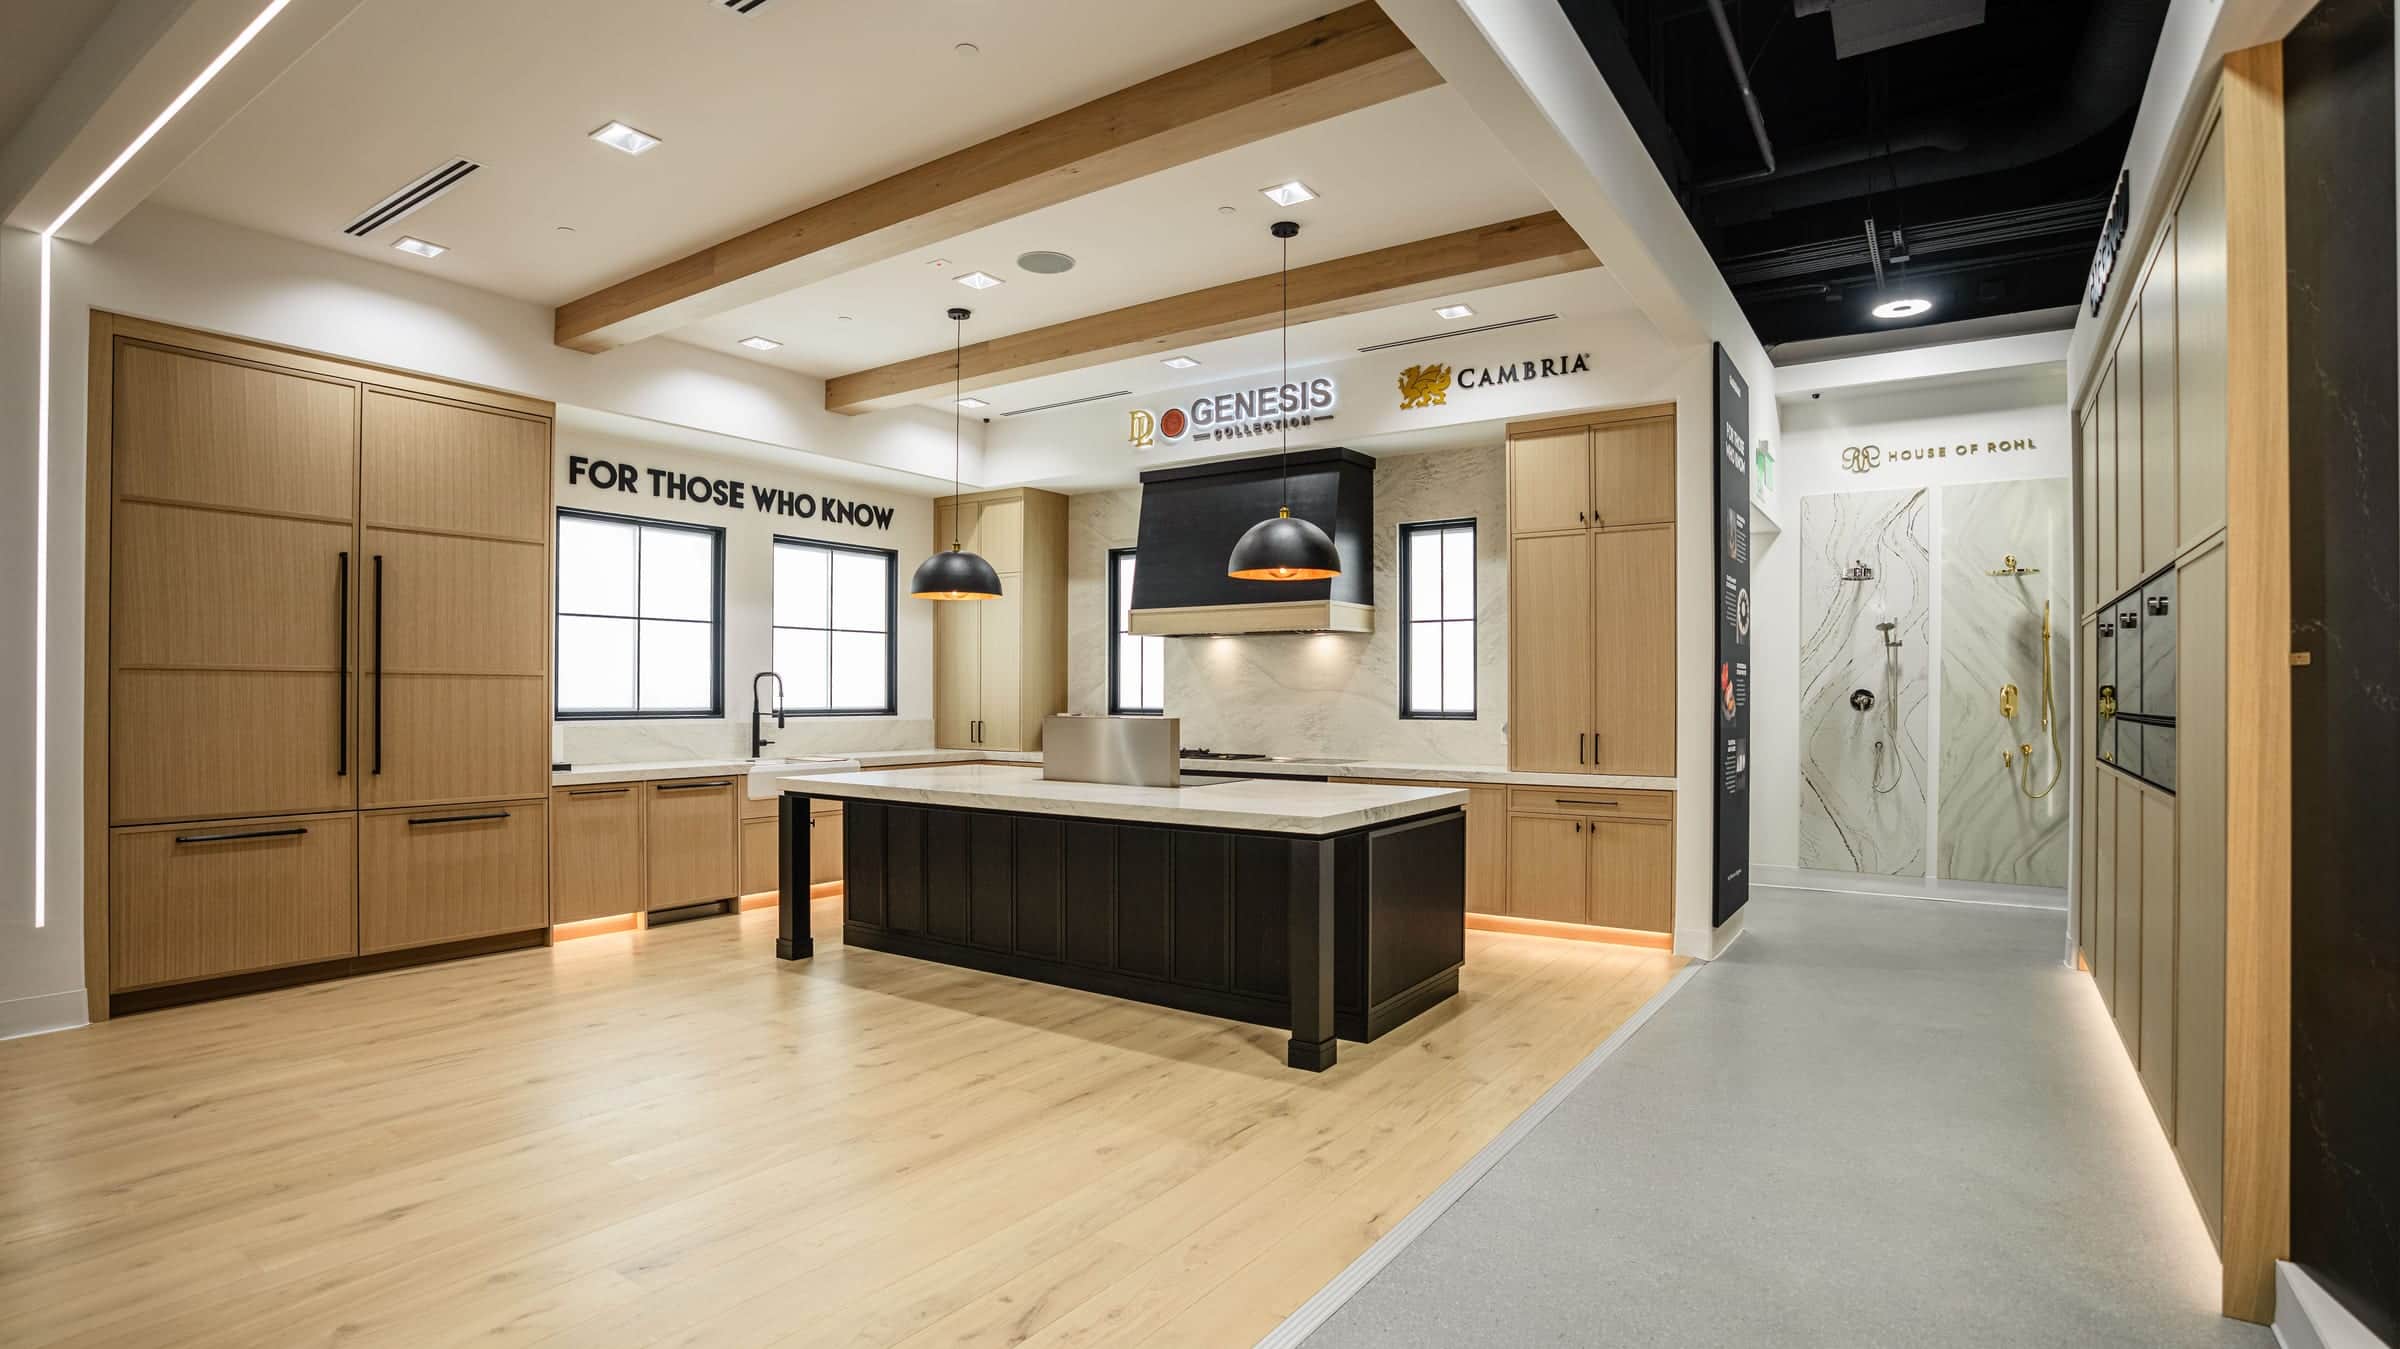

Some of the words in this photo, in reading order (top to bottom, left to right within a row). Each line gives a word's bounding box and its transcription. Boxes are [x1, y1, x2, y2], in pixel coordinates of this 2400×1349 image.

[1457, 352, 1590, 389] CAMBRIA
[1191, 378, 1333, 427] GENESIS
[1214, 415, 1311, 441] COLLECTION
[1888, 446, 1947, 462] HOUSE
[1955, 444, 1978, 456] OF
[1987, 438, 2037, 453] ROHL
[569, 455, 638, 493] FOR
[647, 468, 745, 509] THOSE
[752, 485, 816, 519] WHO
[821, 497, 895, 531] KNOW
